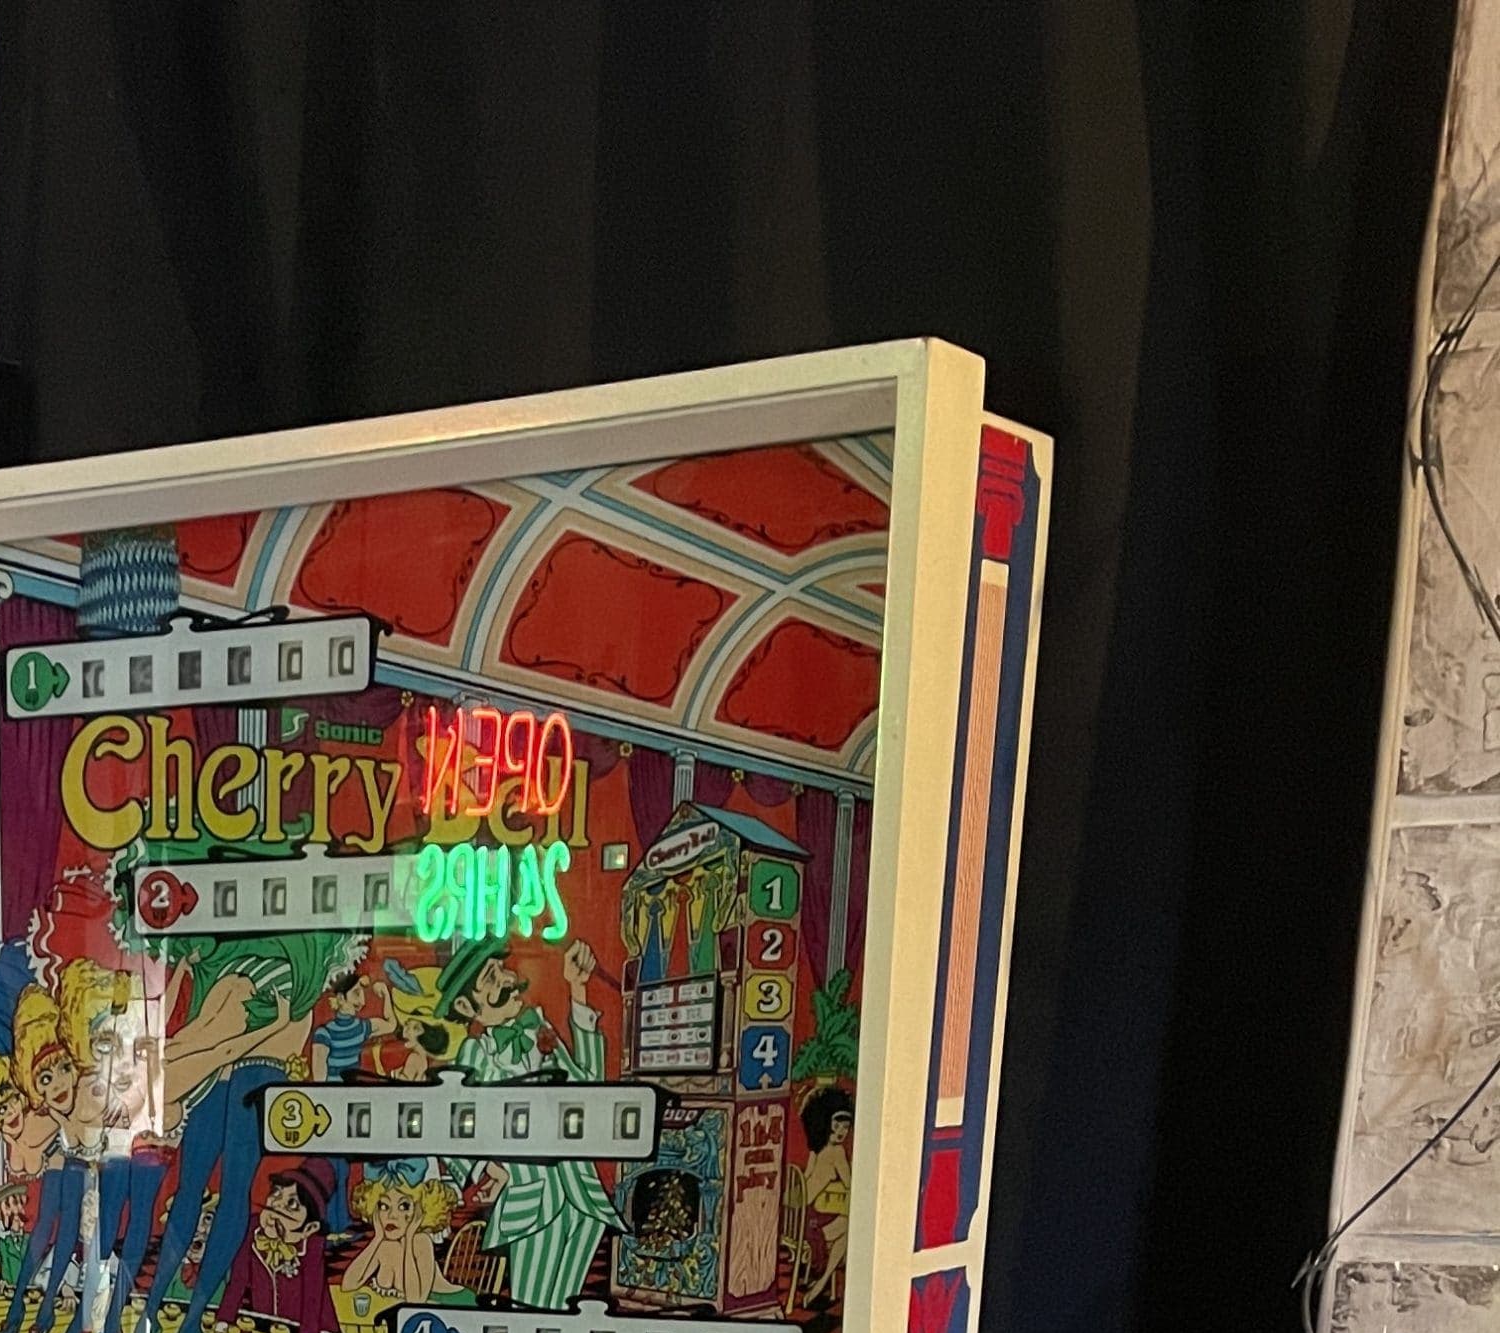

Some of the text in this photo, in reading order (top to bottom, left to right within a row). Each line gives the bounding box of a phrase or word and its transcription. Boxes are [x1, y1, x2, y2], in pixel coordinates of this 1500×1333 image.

[315, 721, 384, 746] Sonic
[61, 714, 404, 853] Cherry
[150, 880, 171, 908] 2
[765, 876, 783, 910] 1
[761, 928, 784, 962] 2
[757, 981, 783, 1013] 3
[752, 1035, 778, 1067] 4
[281, 1098, 303, 1129] 3
